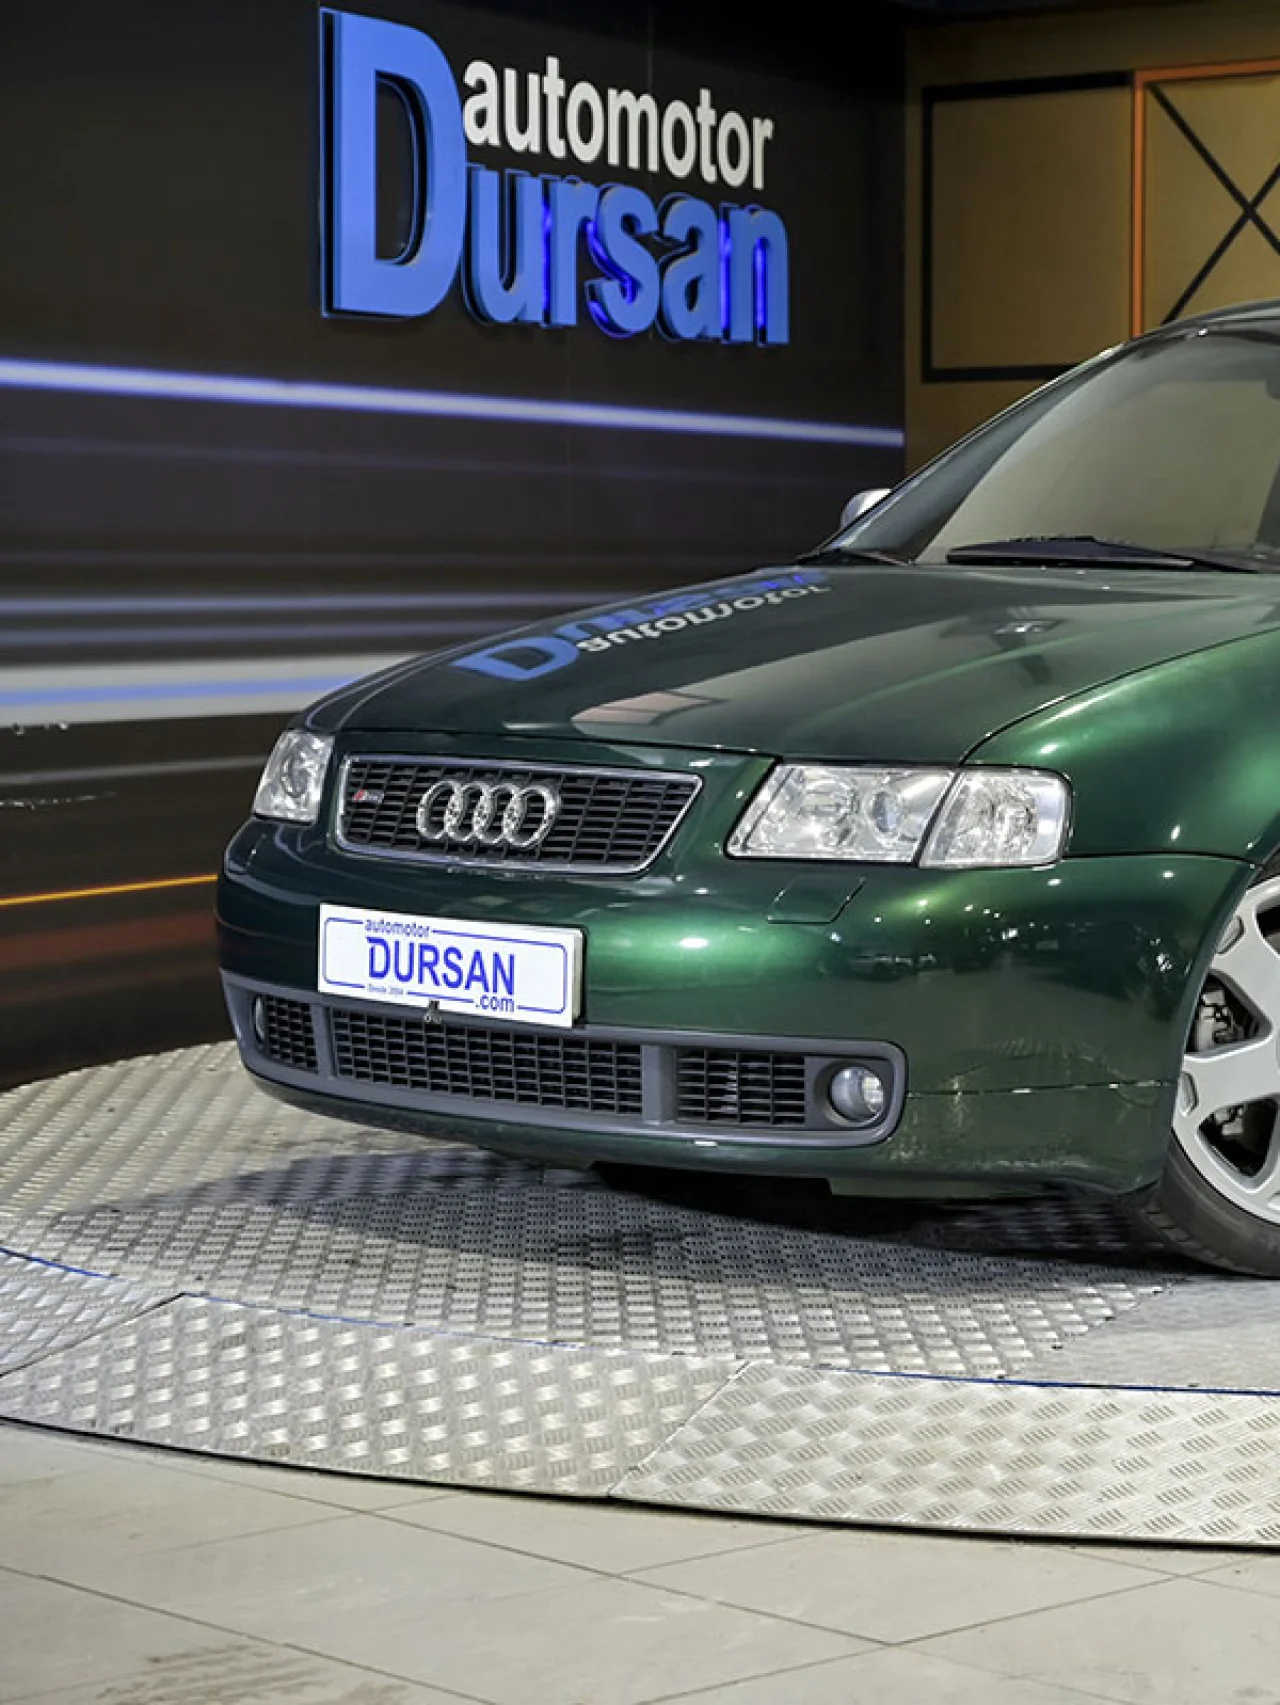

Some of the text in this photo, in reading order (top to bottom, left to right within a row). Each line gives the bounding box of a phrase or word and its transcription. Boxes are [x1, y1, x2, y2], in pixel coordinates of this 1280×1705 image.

[463, 56, 773, 189] automotor
[320, 7, 789, 346] Dursan
[364, 918, 430, 938] automotor
[366, 936, 515, 995] DURSAN
[475, 994, 515, 1013] .com
